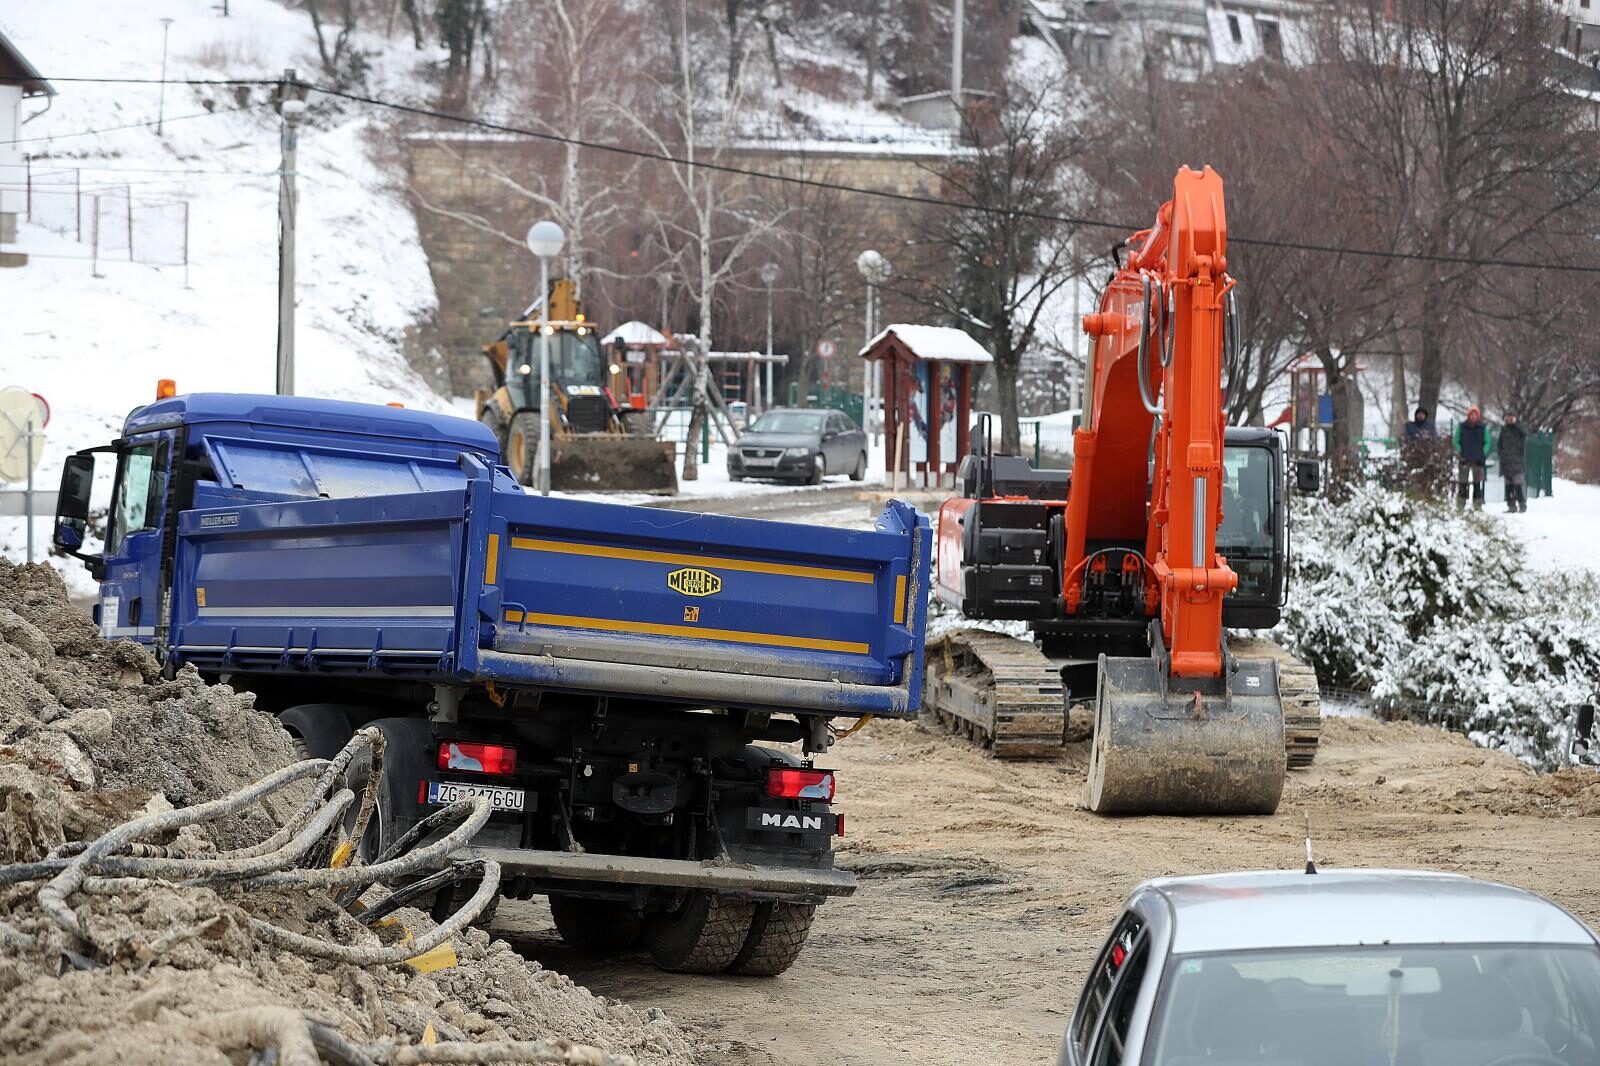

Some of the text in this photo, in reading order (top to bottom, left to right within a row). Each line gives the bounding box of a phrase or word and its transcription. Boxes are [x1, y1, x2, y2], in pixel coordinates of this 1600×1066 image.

[670, 570, 720, 594] MEILLER
[440, 786, 457, 802] ZG
[761, 813, 822, 830] MAN
